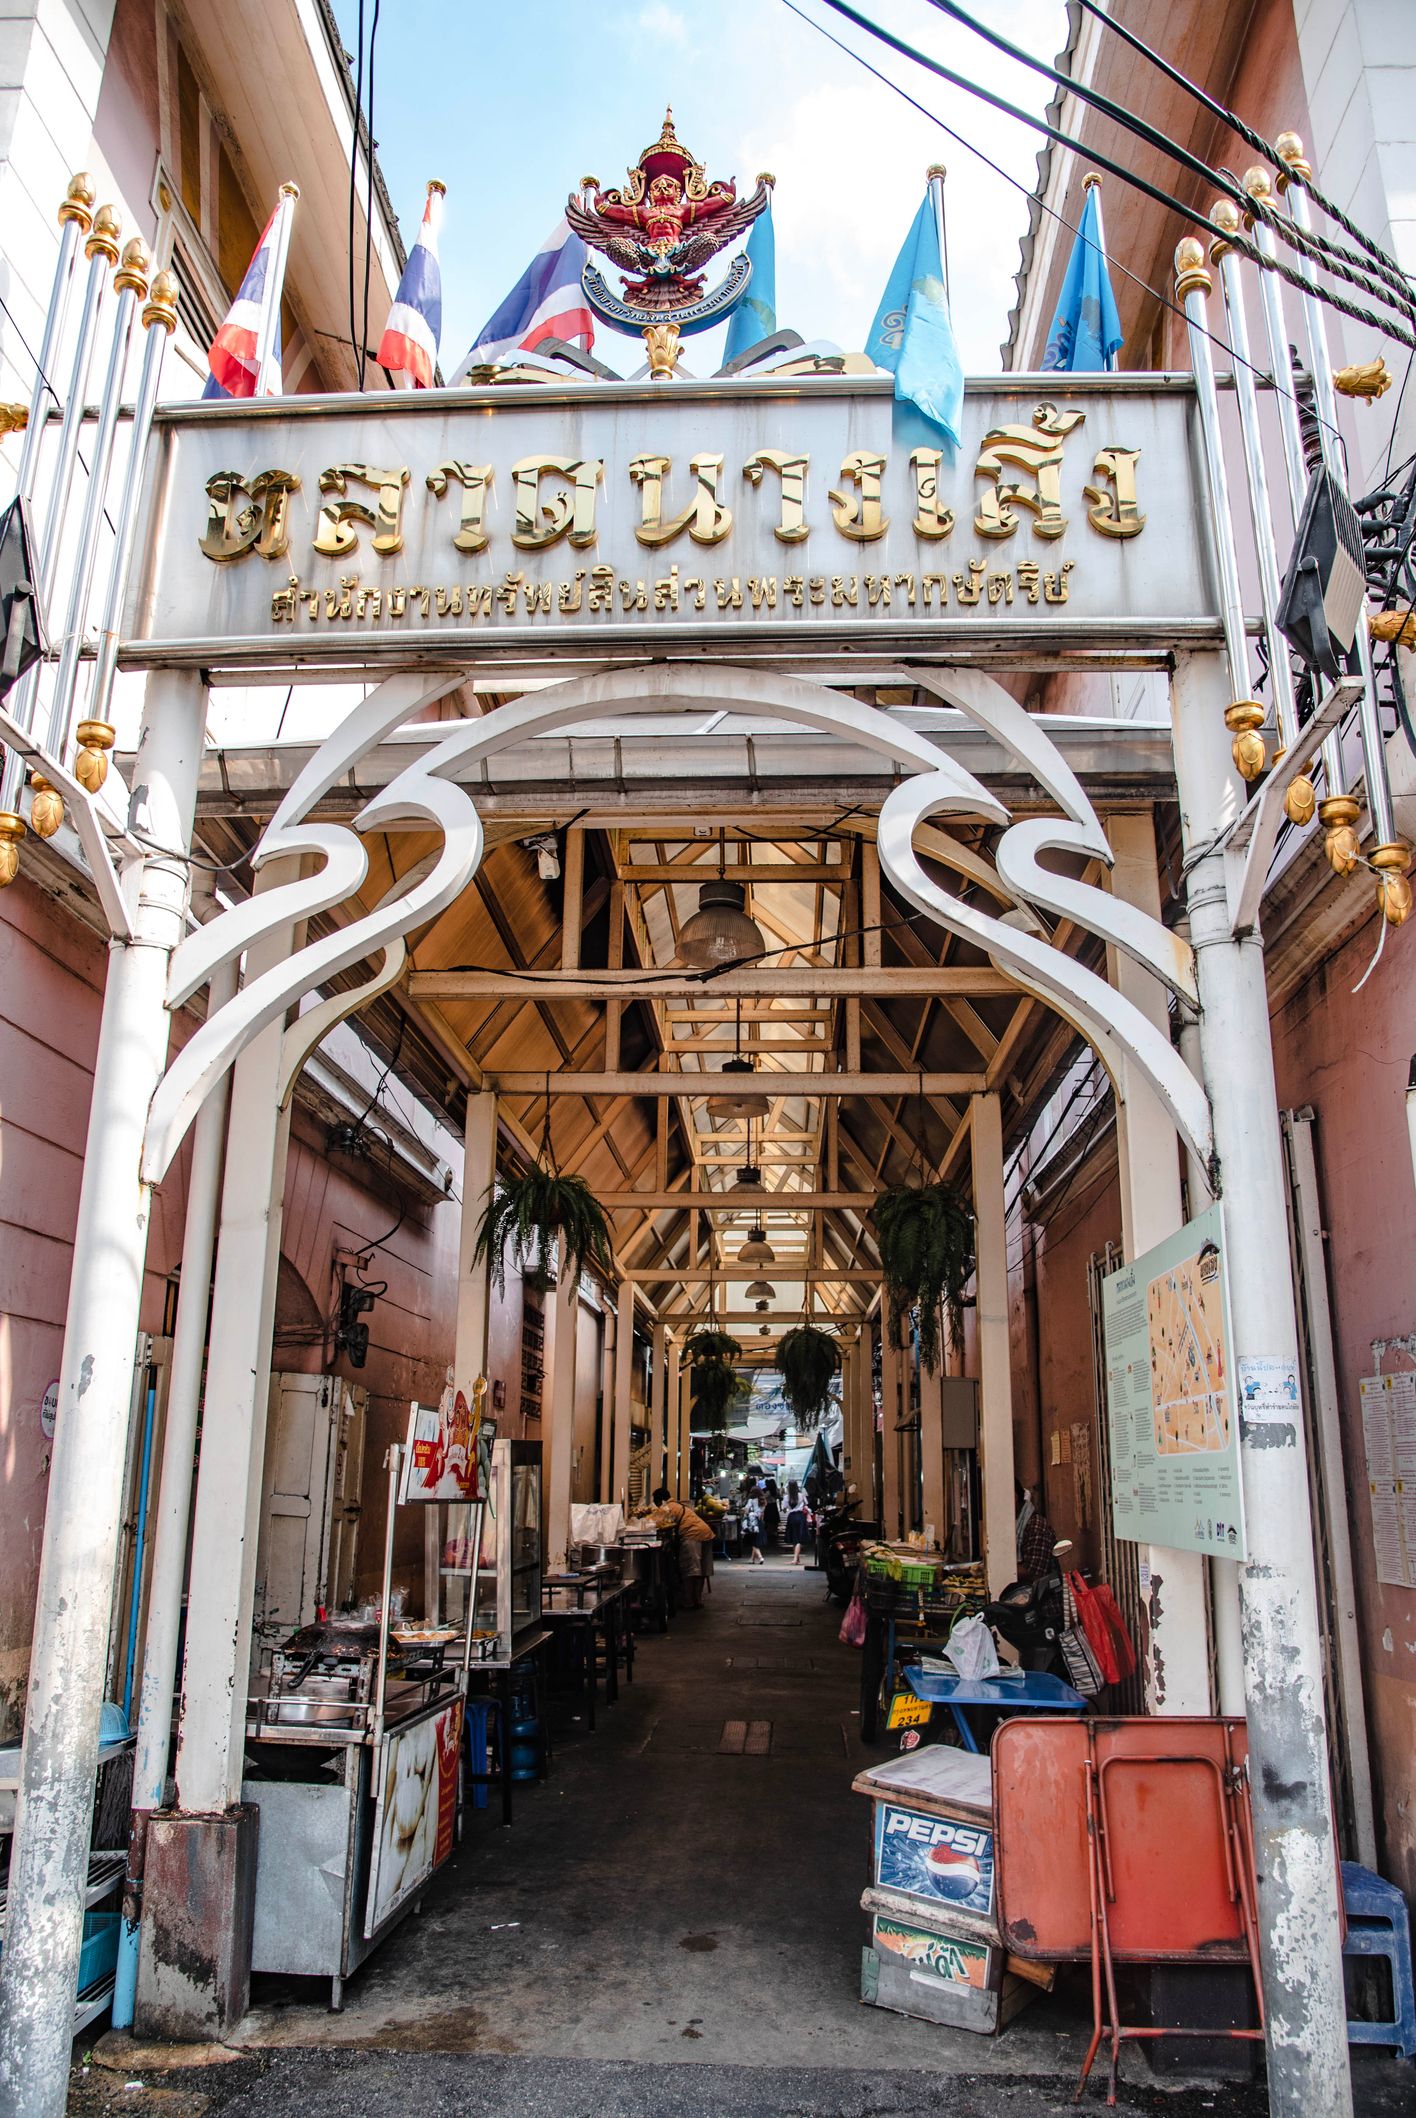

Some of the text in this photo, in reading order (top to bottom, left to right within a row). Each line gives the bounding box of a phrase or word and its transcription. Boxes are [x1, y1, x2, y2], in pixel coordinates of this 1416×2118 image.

[198, 402, 1146, 562] ตลาดนางเลิ้ง
[271, 558, 1076, 622] สำนักงานทรัพย์สินส่วนพระมหากษัตริย์
[897, 1714, 921, 1727] 234
[885, 1812, 988, 1857] PEPSI
